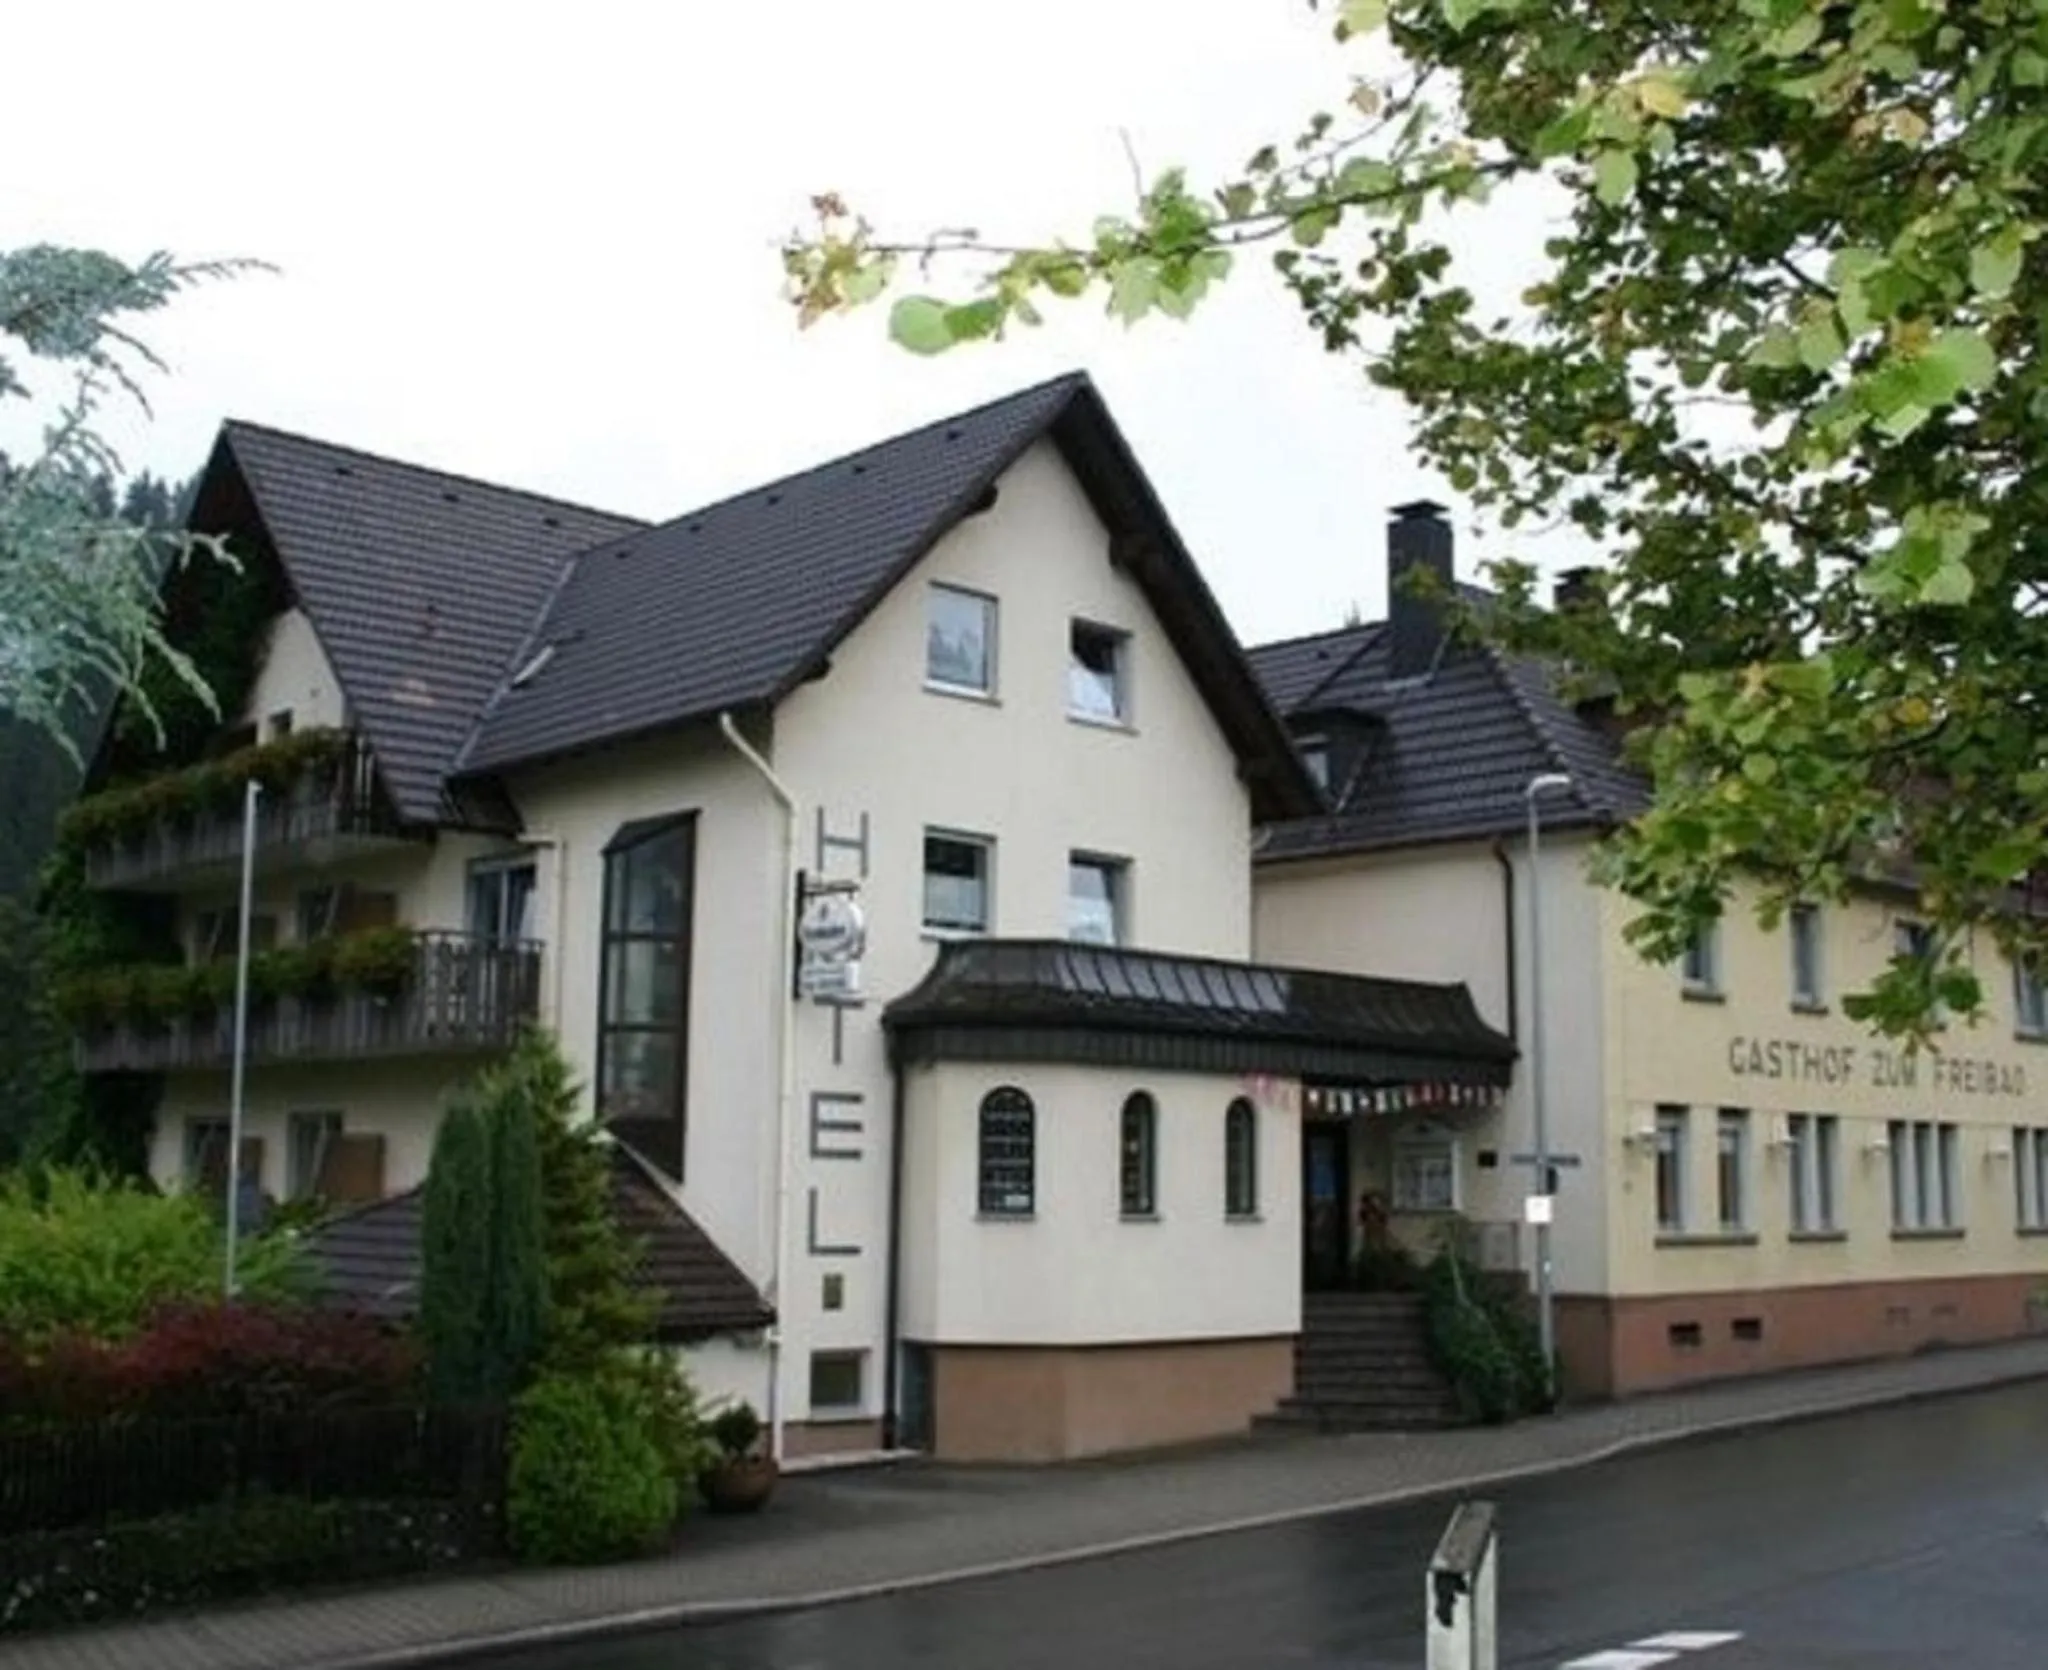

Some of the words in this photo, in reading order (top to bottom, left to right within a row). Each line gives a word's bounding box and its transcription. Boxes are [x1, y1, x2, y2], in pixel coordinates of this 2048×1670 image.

[808, 806, 868, 1256] HTEL
[1728, 1035, 1855, 1084] GASTHOF
[1871, 1050, 1918, 1087] ZUM
[1933, 1056, 2025, 1096] FREIBAD
